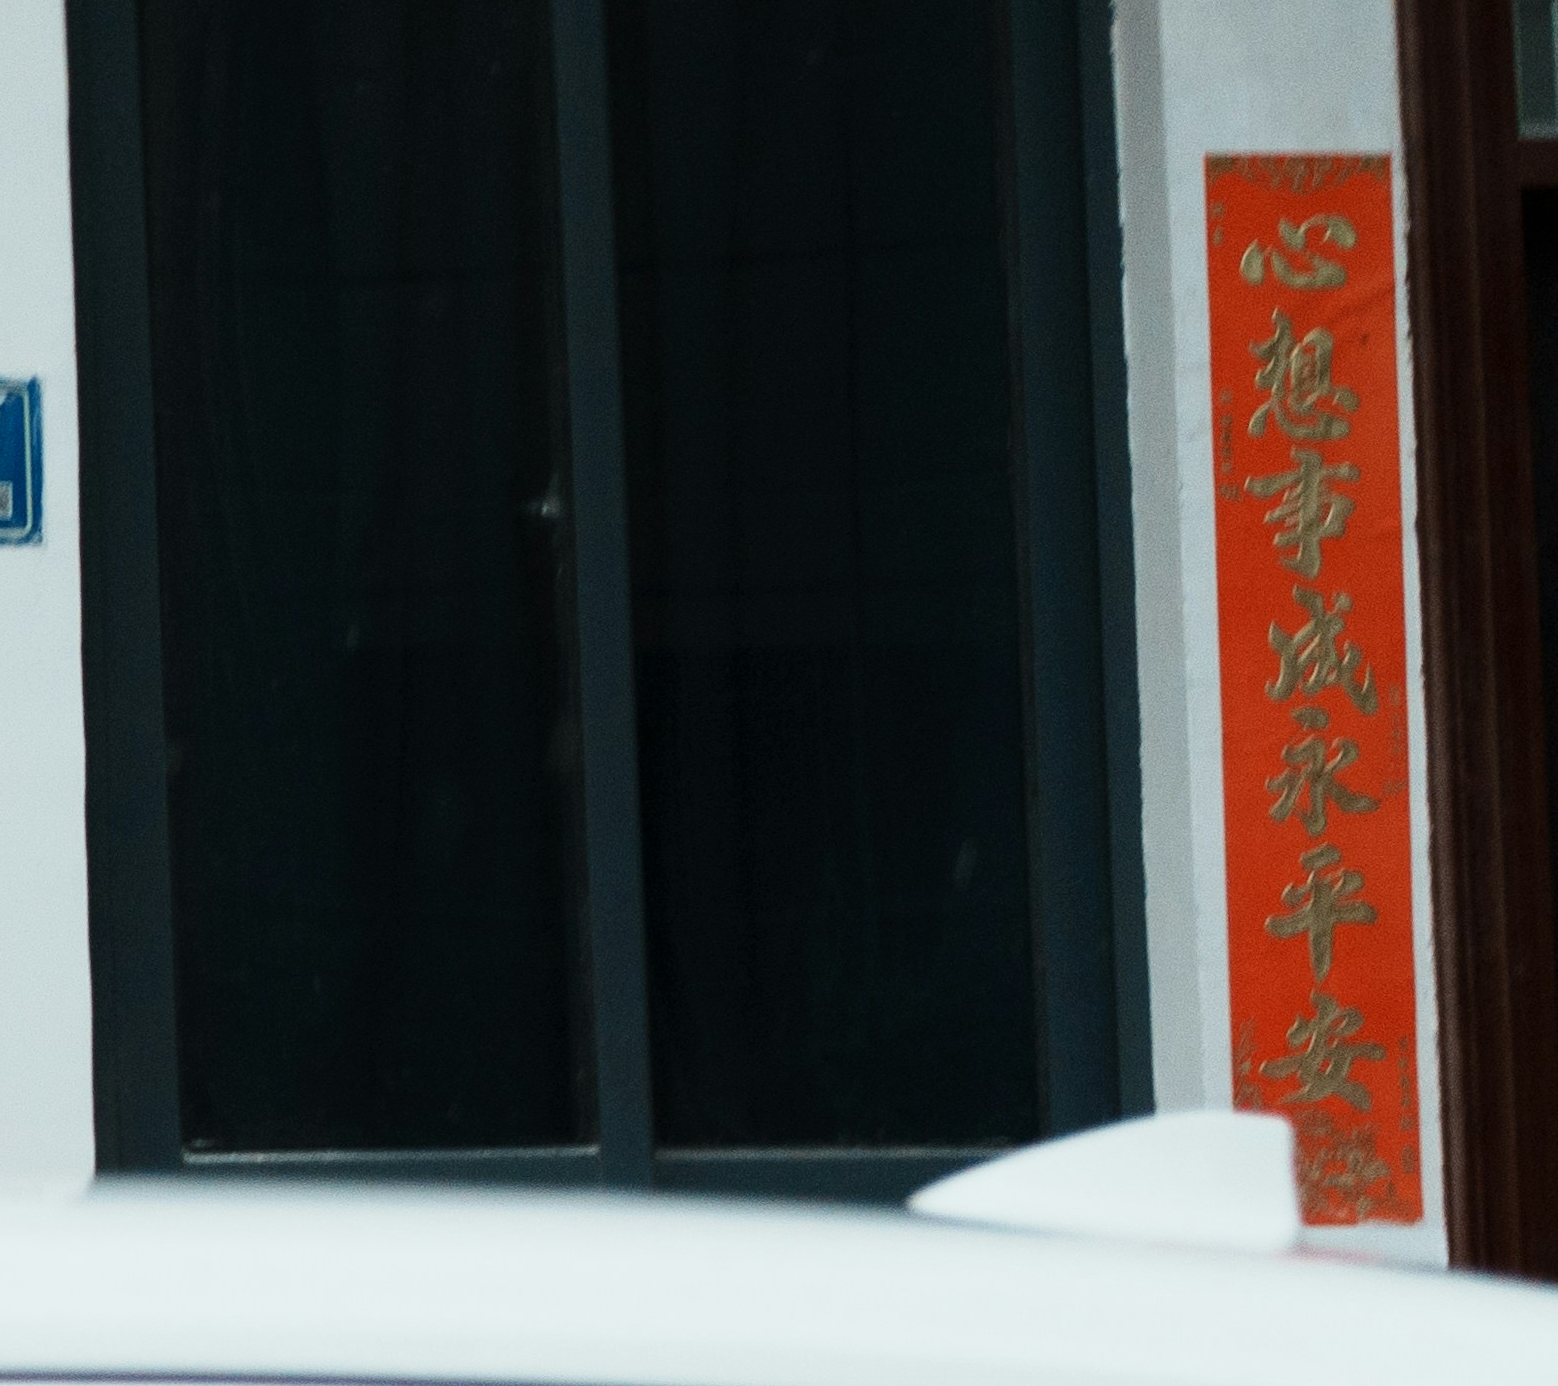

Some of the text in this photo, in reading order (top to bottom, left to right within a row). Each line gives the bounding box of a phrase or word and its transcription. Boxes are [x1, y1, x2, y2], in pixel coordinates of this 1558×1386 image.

[1239, 213, 1387, 1113] 心想事成永平安
